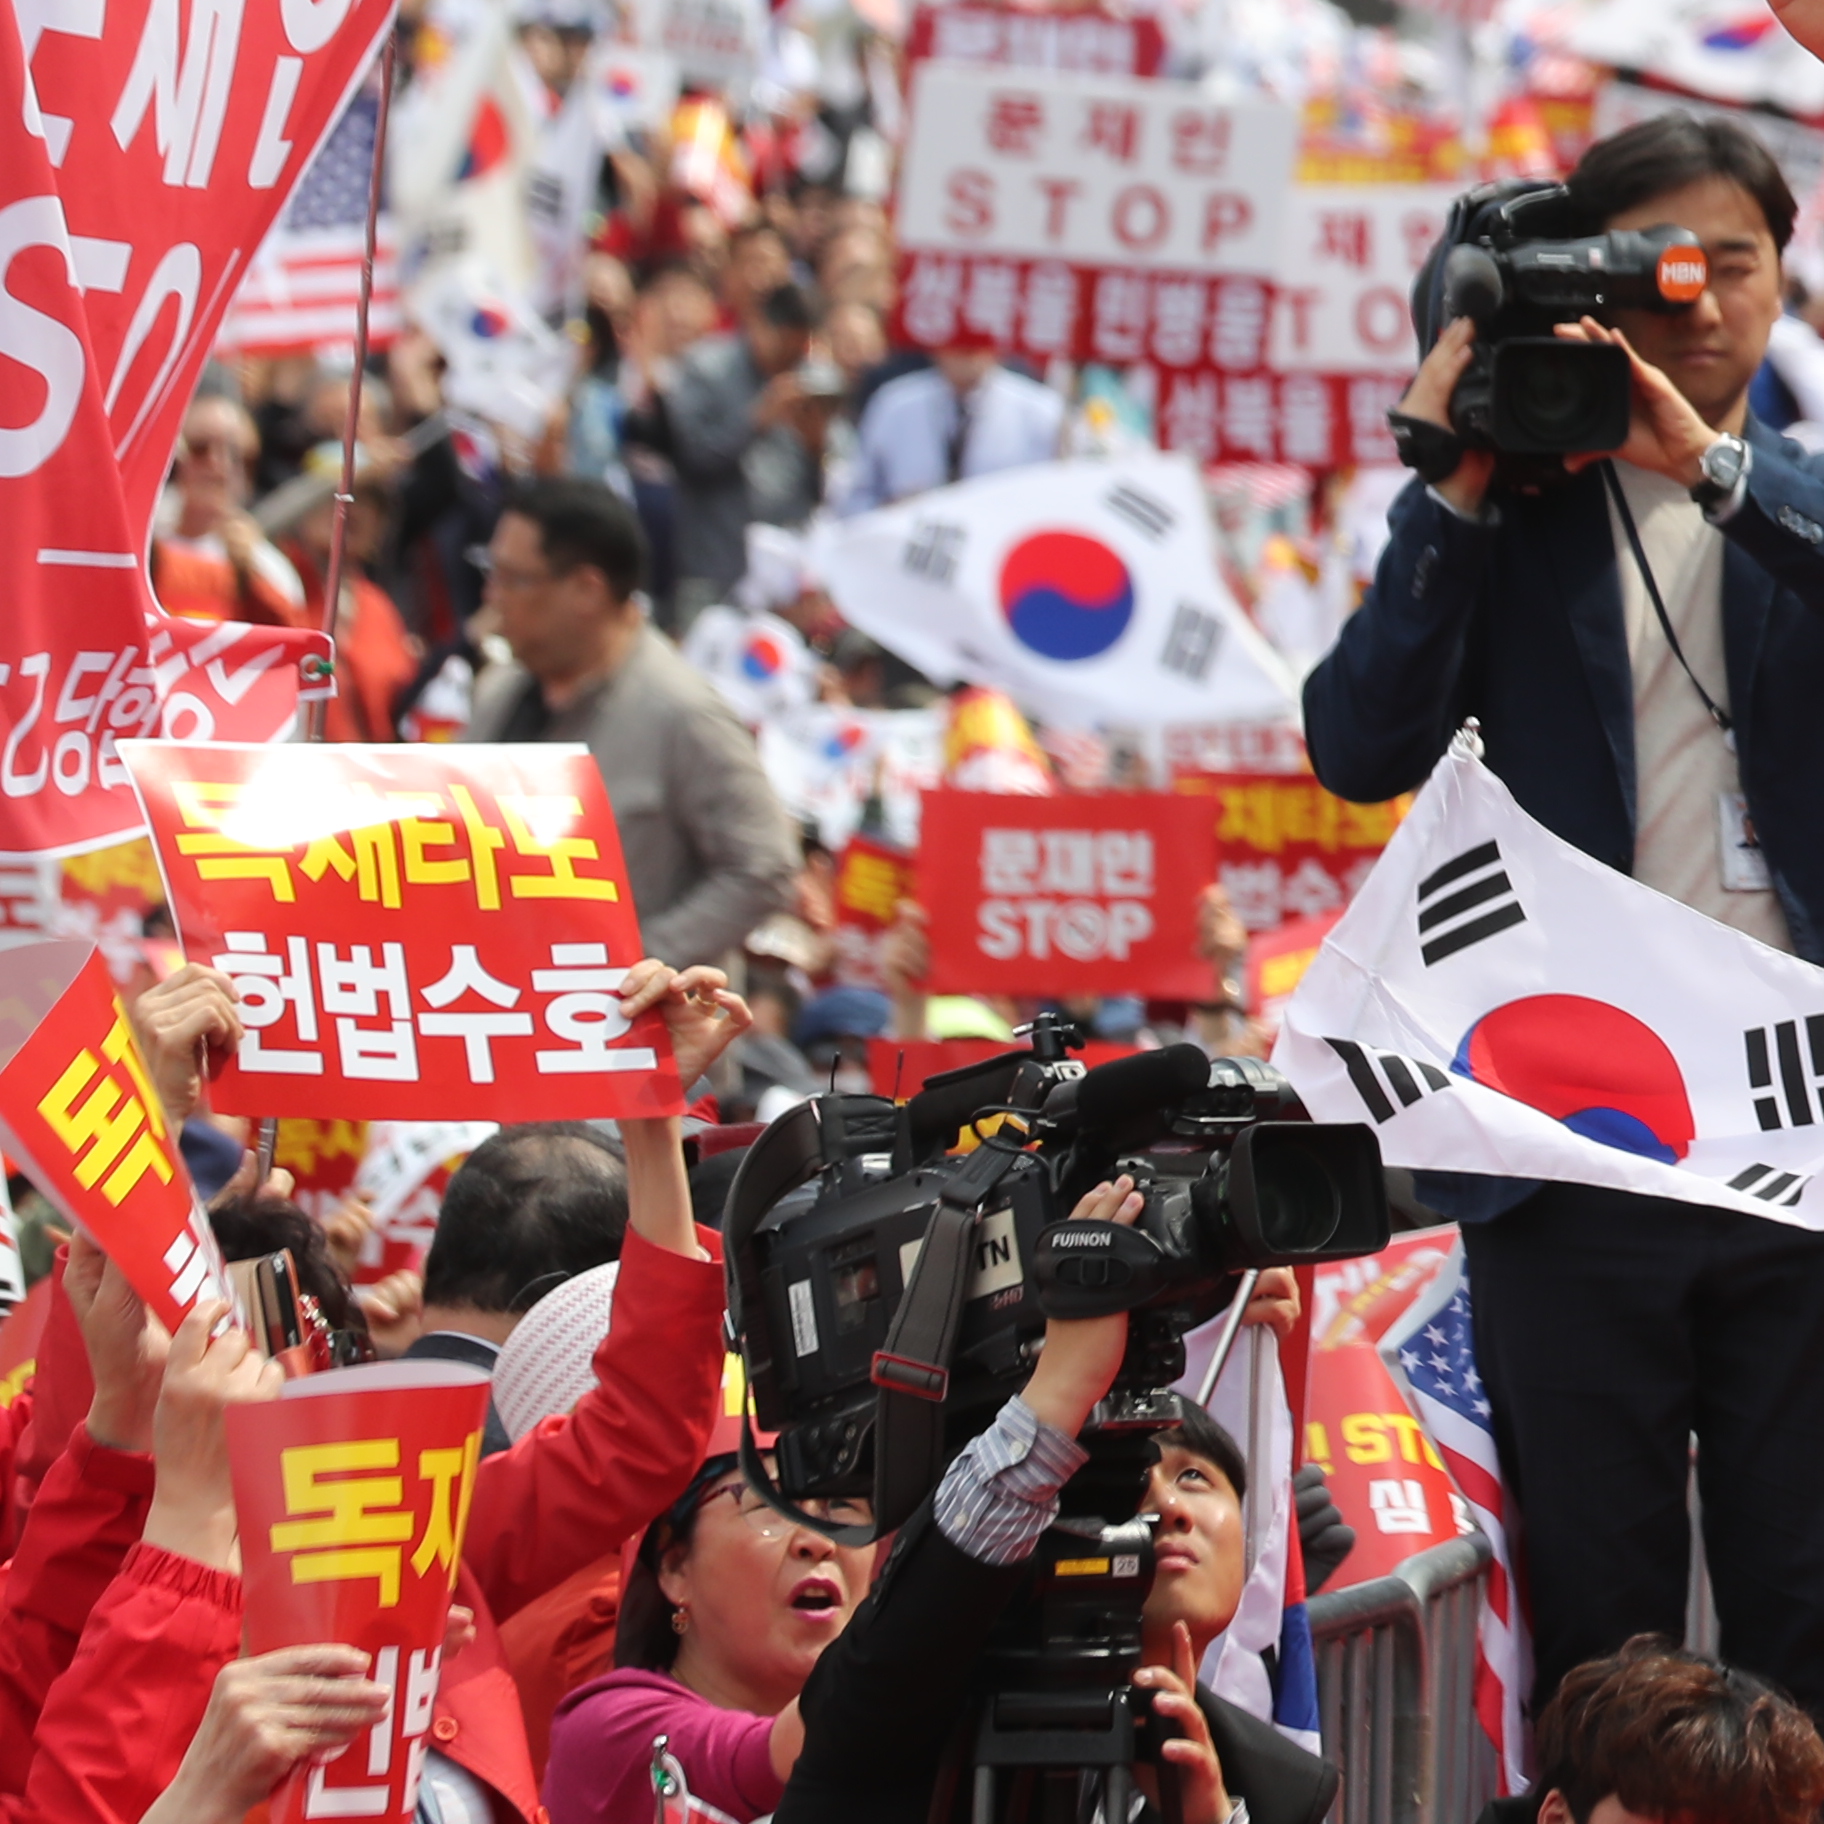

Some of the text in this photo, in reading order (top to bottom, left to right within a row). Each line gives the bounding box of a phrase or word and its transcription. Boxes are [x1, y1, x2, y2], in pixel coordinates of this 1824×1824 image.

[944, 166, 1254, 256] STOP
[1660, 261, 1706, 285] MBN
[1280, 284, 1413, 354] TO
[979, 828, 1154, 898] 문재인
[211, 931, 658, 1084] 헌법수호
[976, 1234, 1011, 1272] TN
[1051, 1231, 1111, 1249] FUJINON
